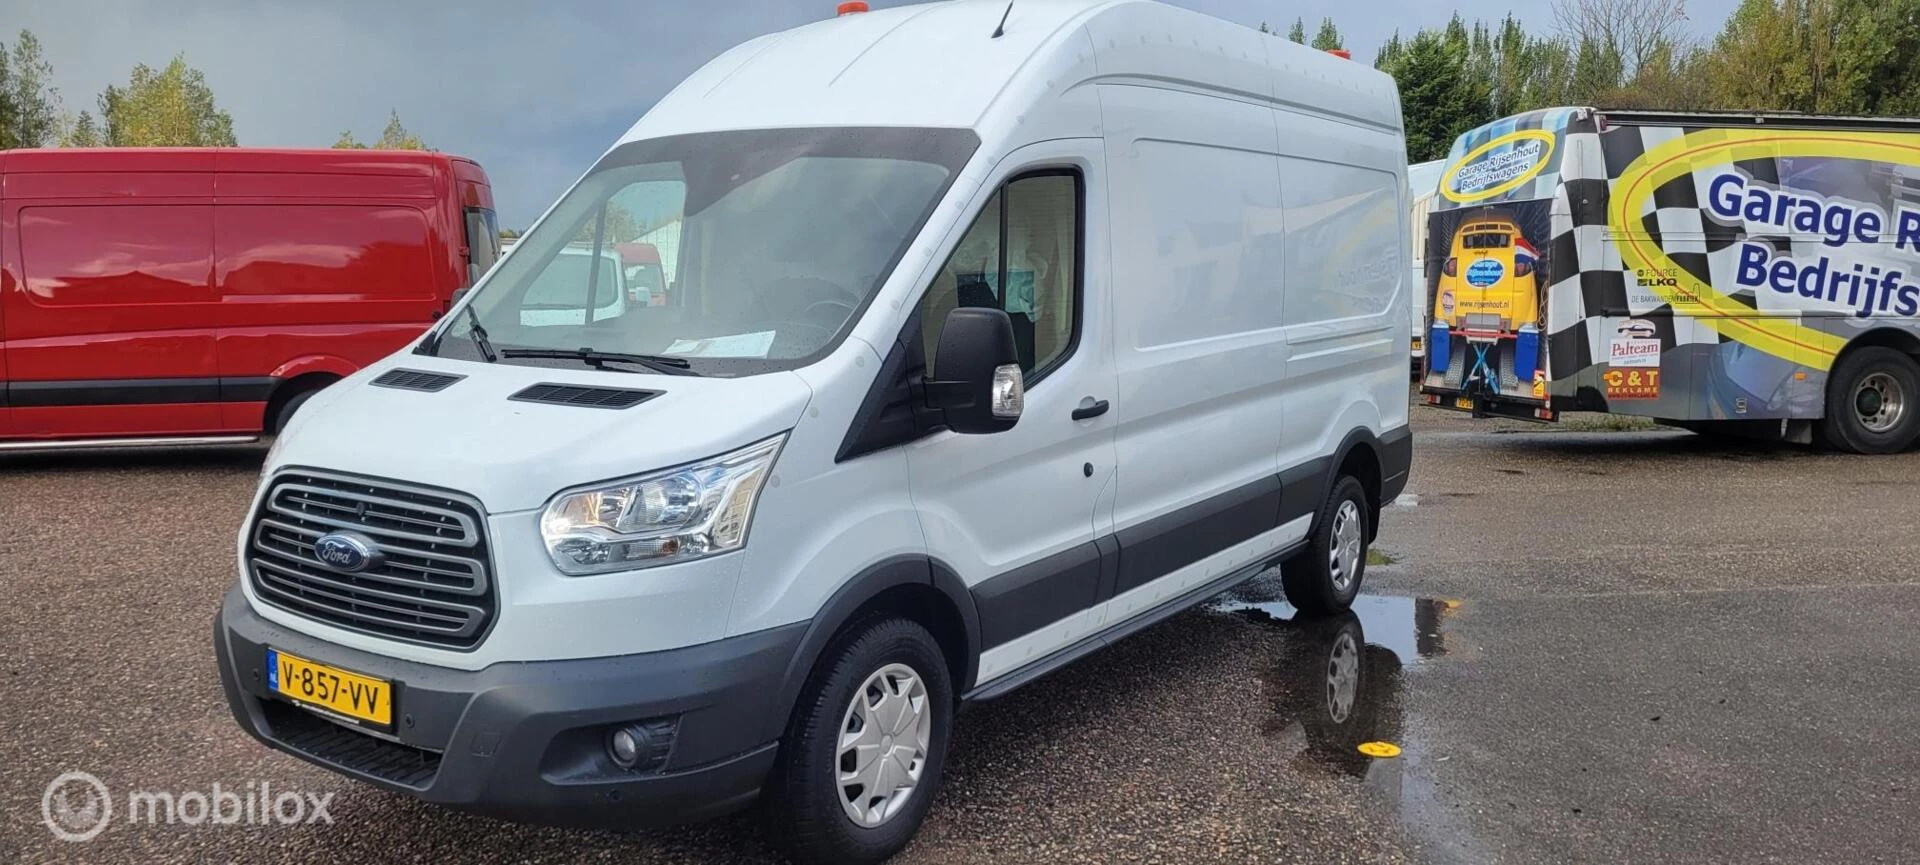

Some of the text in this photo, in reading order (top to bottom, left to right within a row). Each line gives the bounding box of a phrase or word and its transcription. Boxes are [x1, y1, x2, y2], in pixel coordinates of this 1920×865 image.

[1458, 143, 1539, 178] Garage Rijsenhout
[1462, 162, 1529, 190] Bedrijfswagens
[1709, 173, 1881, 247] Garage
[1612, 341, 1658, 356] Palteam
[1627, 371, 1642, 387] &
[1646, 371, 1658, 386] T
[322, 541, 351, 564] Ford
[283, 661, 379, 715] V-857-VV
